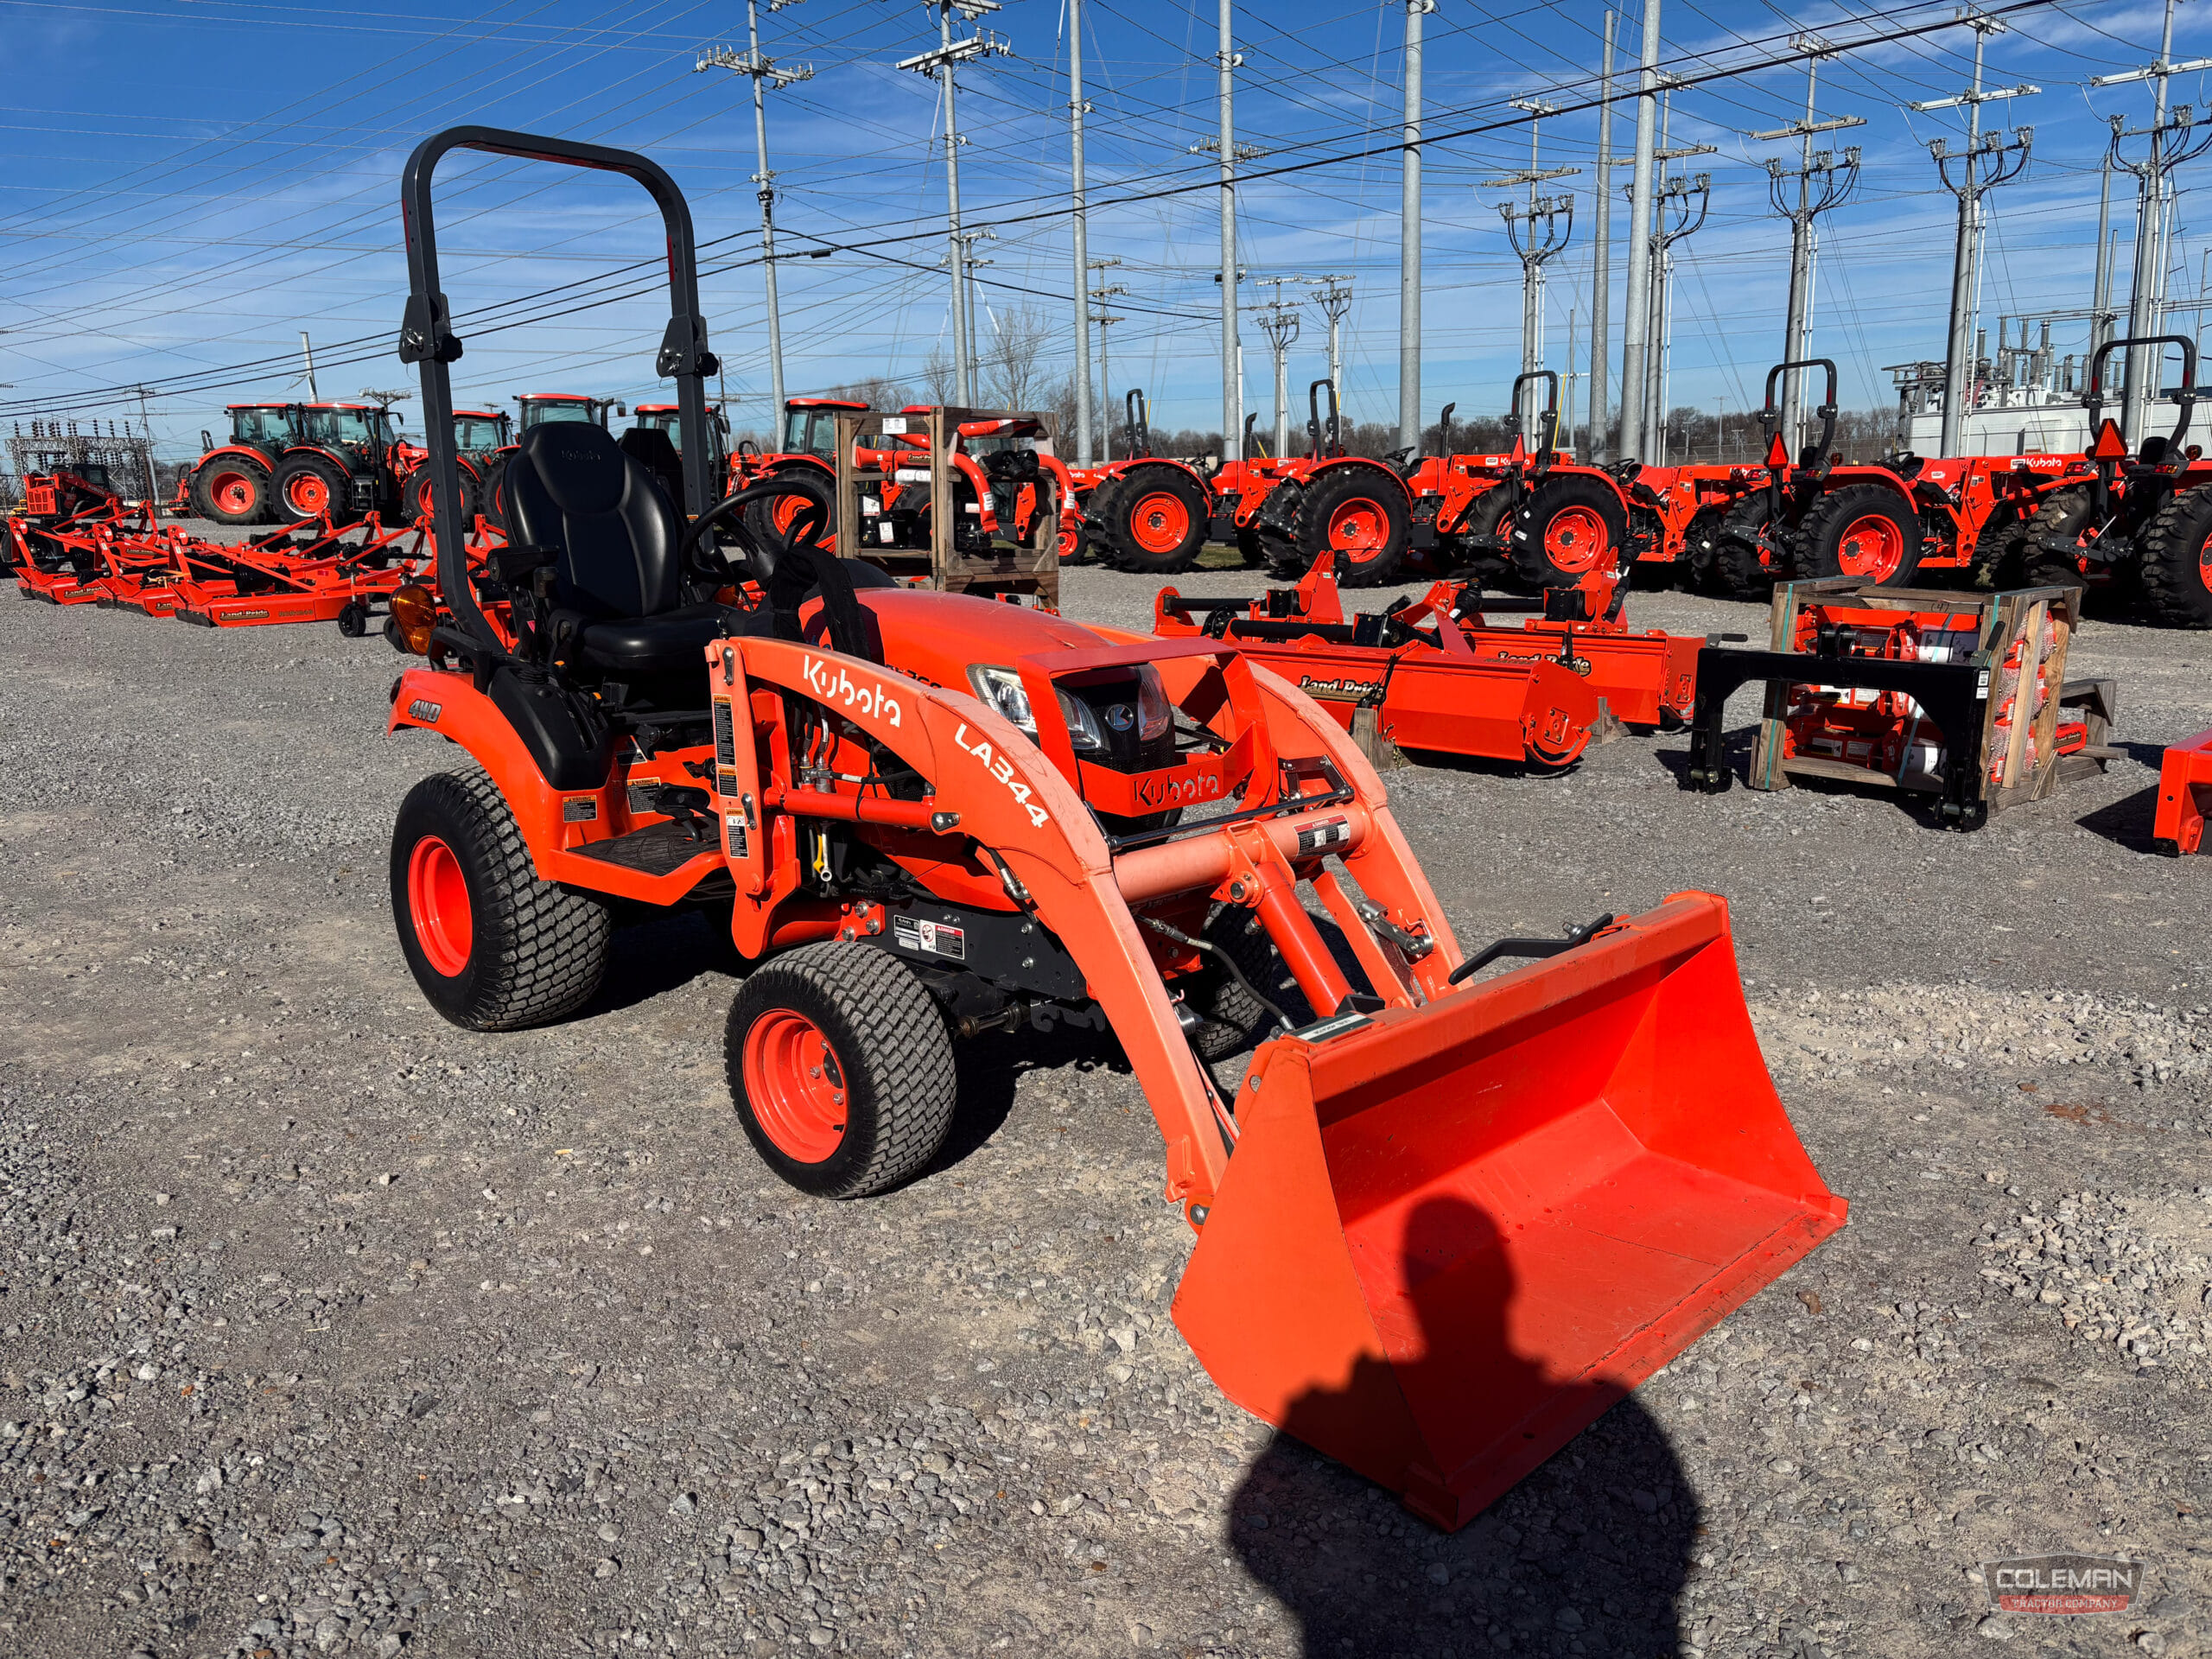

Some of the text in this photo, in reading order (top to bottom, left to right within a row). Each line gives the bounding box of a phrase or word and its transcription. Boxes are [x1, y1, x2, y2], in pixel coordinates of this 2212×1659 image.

[2026, 457, 2062, 467] Kubota
[220, 610, 243, 620] Land
[245, 608, 269, 619] Pride
[802, 653, 901, 728] Kubota
[1299, 675, 1341, 696] Land
[408, 698, 442, 724] 4WD
[954, 722, 1050, 829] LA344
[1133, 768, 1219, 807] Kubota
